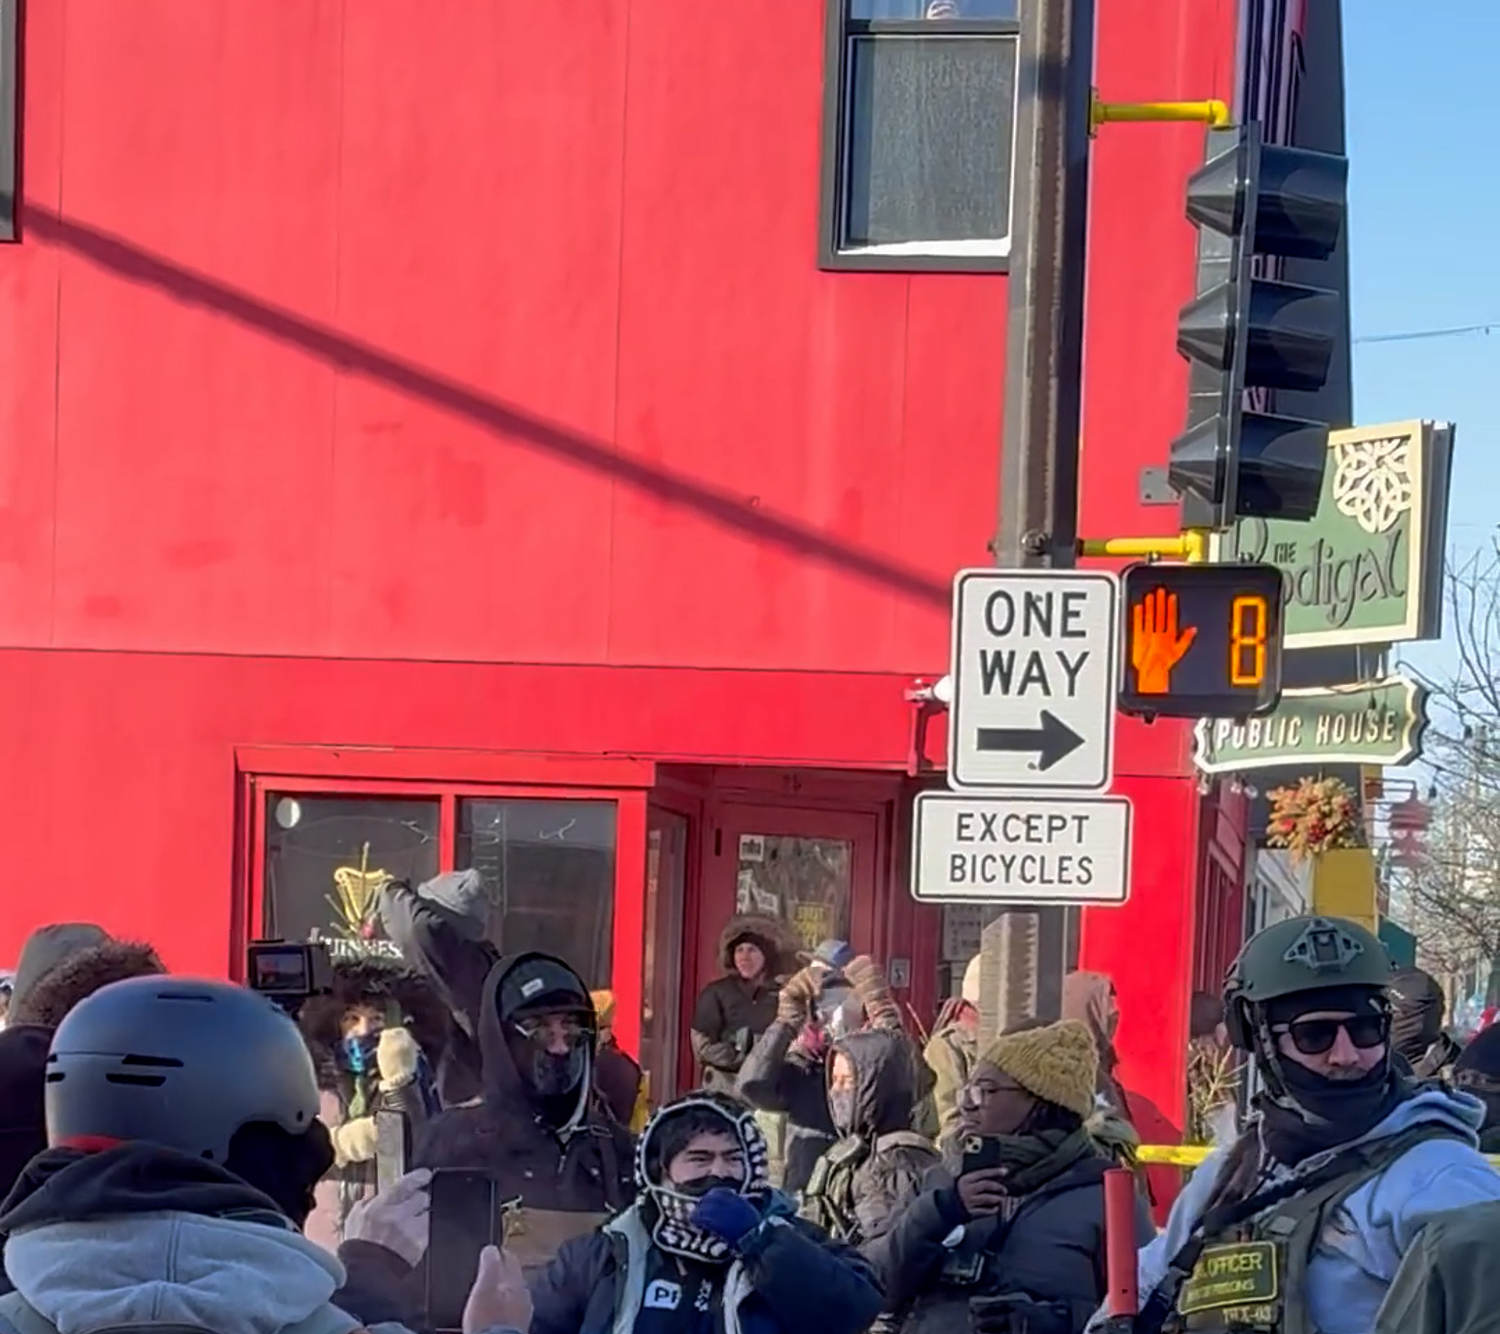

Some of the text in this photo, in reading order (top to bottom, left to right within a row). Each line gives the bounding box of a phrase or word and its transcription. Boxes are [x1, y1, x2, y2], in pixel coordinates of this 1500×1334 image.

[1273, 541, 1297, 564] THE
[984, 589, 1088, 638] ONE
[1231, 595, 1267, 685] 8
[978, 649, 1090, 697] WAY
[1216, 710, 1396, 750] PUBLIC HOUSE
[956, 812, 1090, 844] EXCEPT
[949, 853, 1094, 885] BICYCLES
